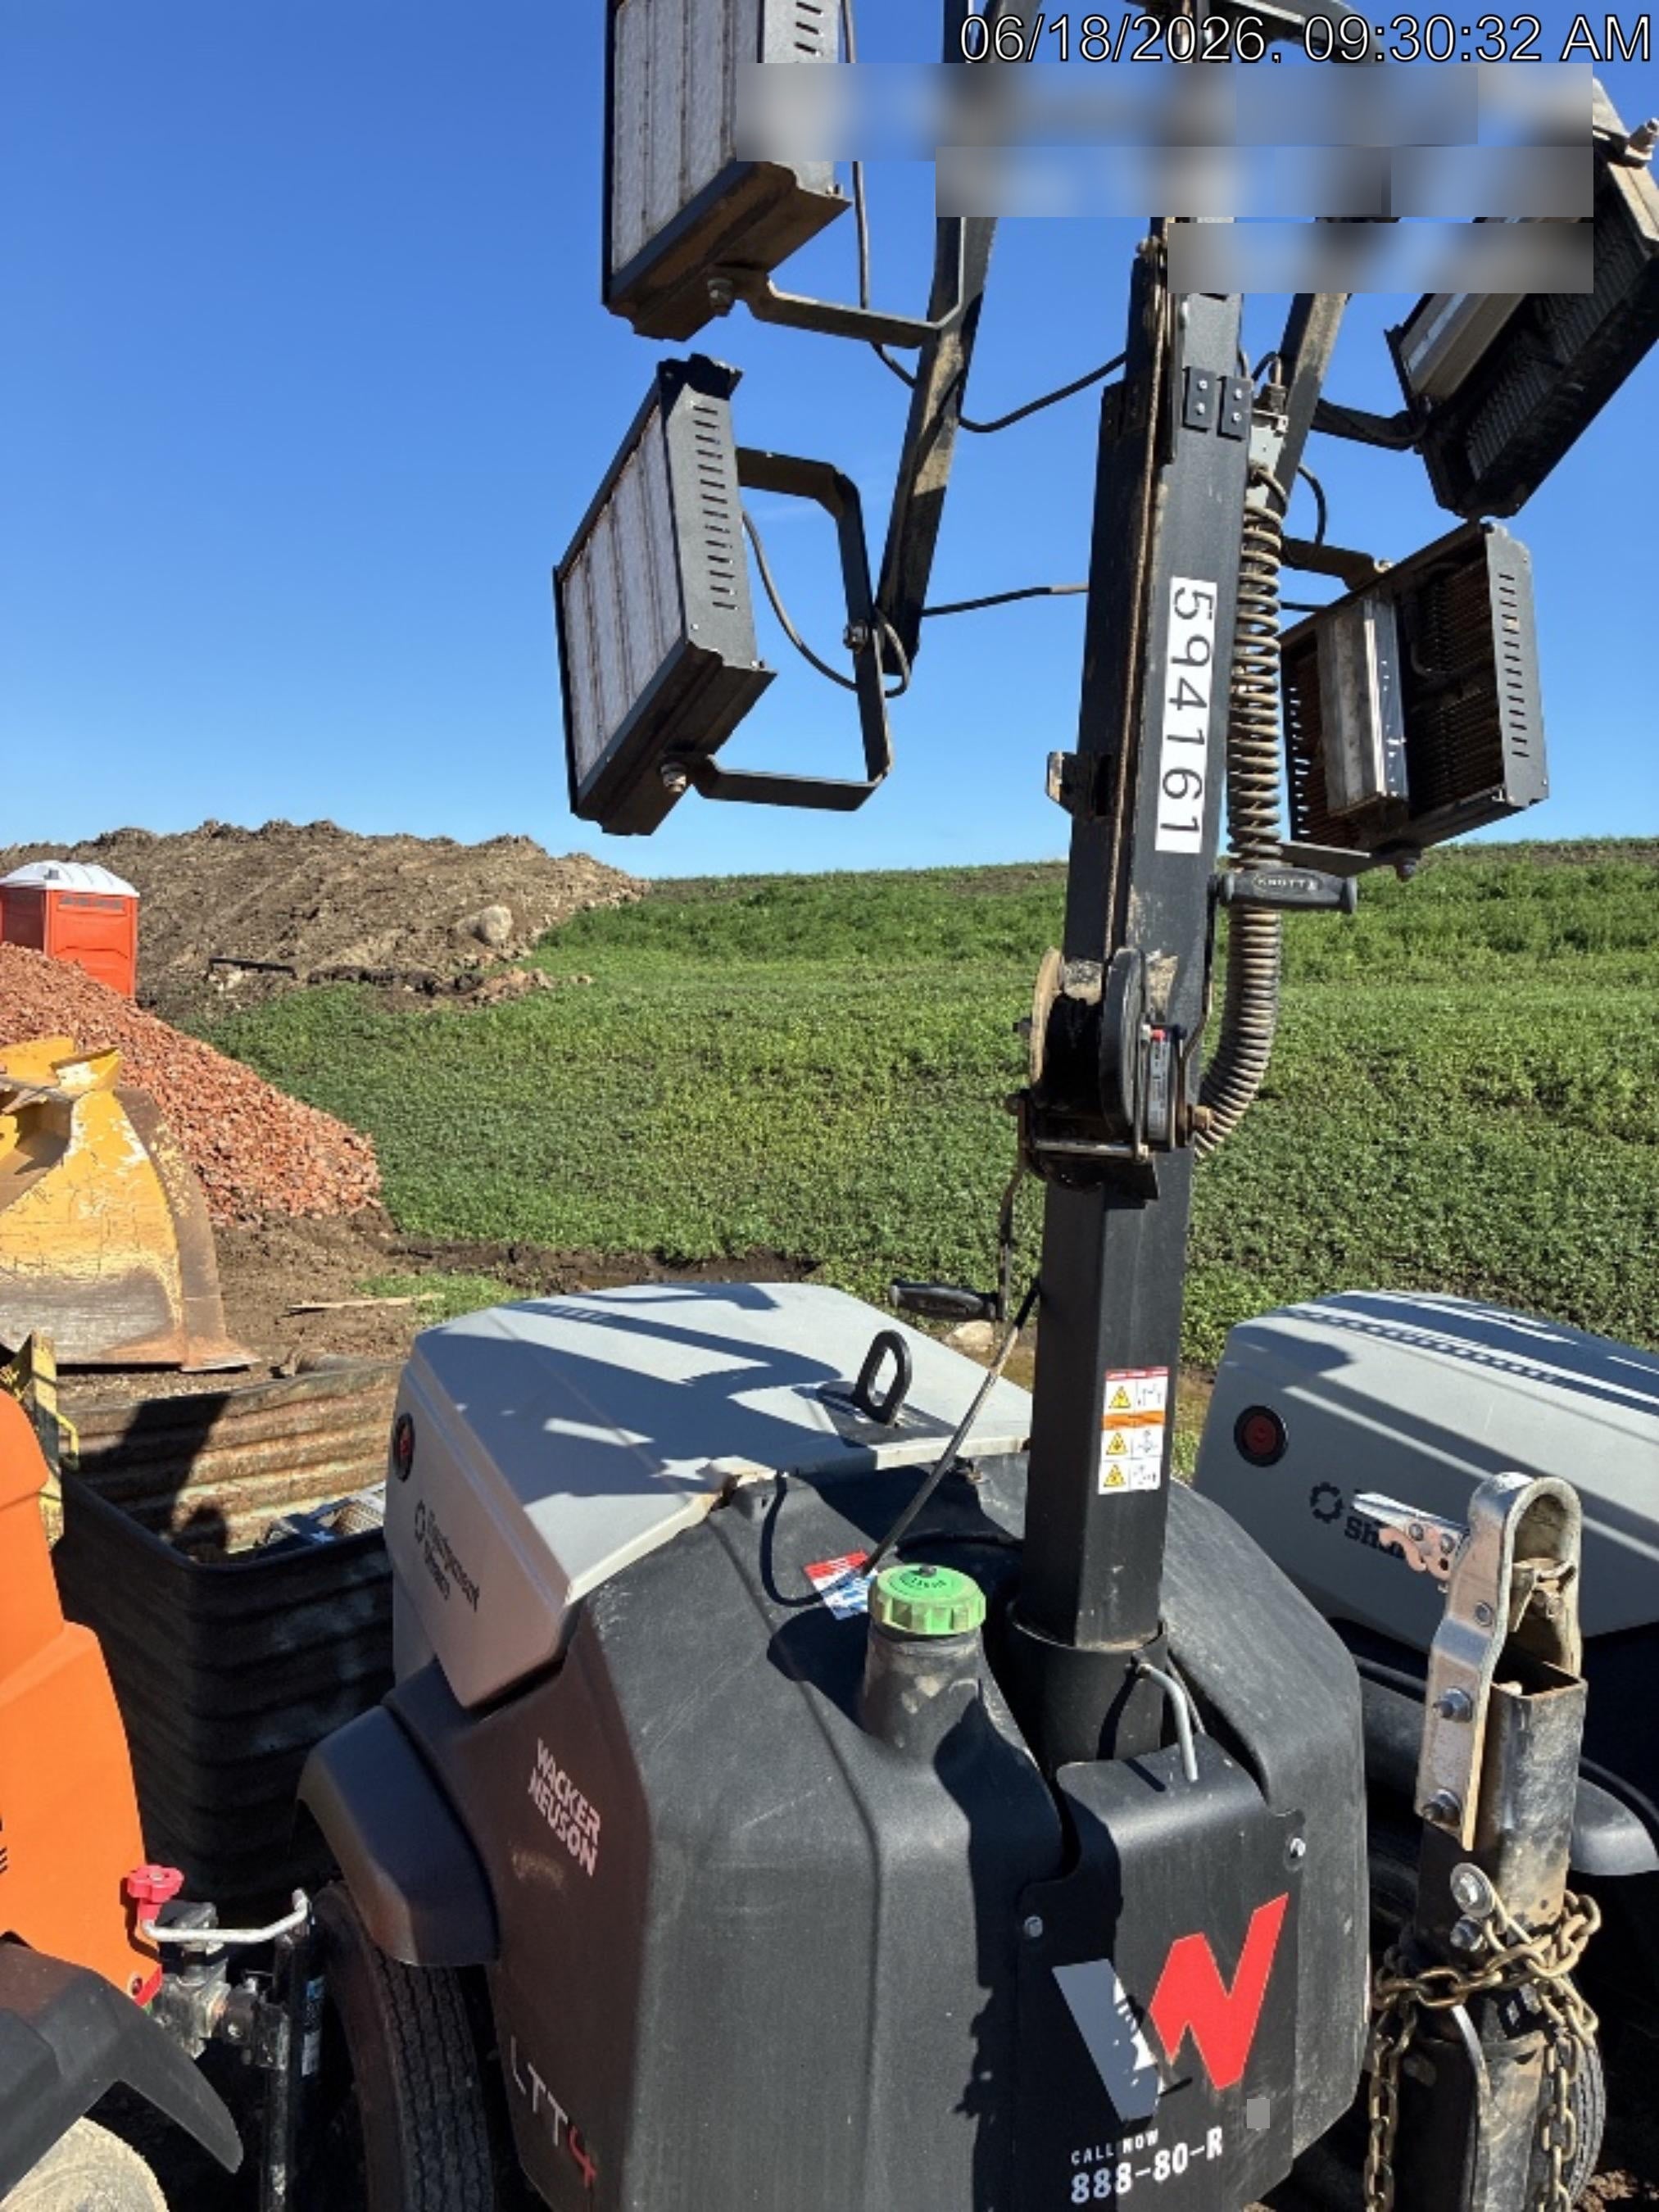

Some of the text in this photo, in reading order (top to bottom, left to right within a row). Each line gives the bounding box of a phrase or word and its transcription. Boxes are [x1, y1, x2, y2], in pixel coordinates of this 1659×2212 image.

[1159, 585, 1215, 836] 594161
[528, 1766, 599, 1878] NEUSON
[537, 1736, 601, 1847] WACKER
[510, 2034, 598, 2189] LTT4
[1070, 2124, 1223, 2204] 888-80-R
[1071, 2128, 1160, 2165] CALL NOW
